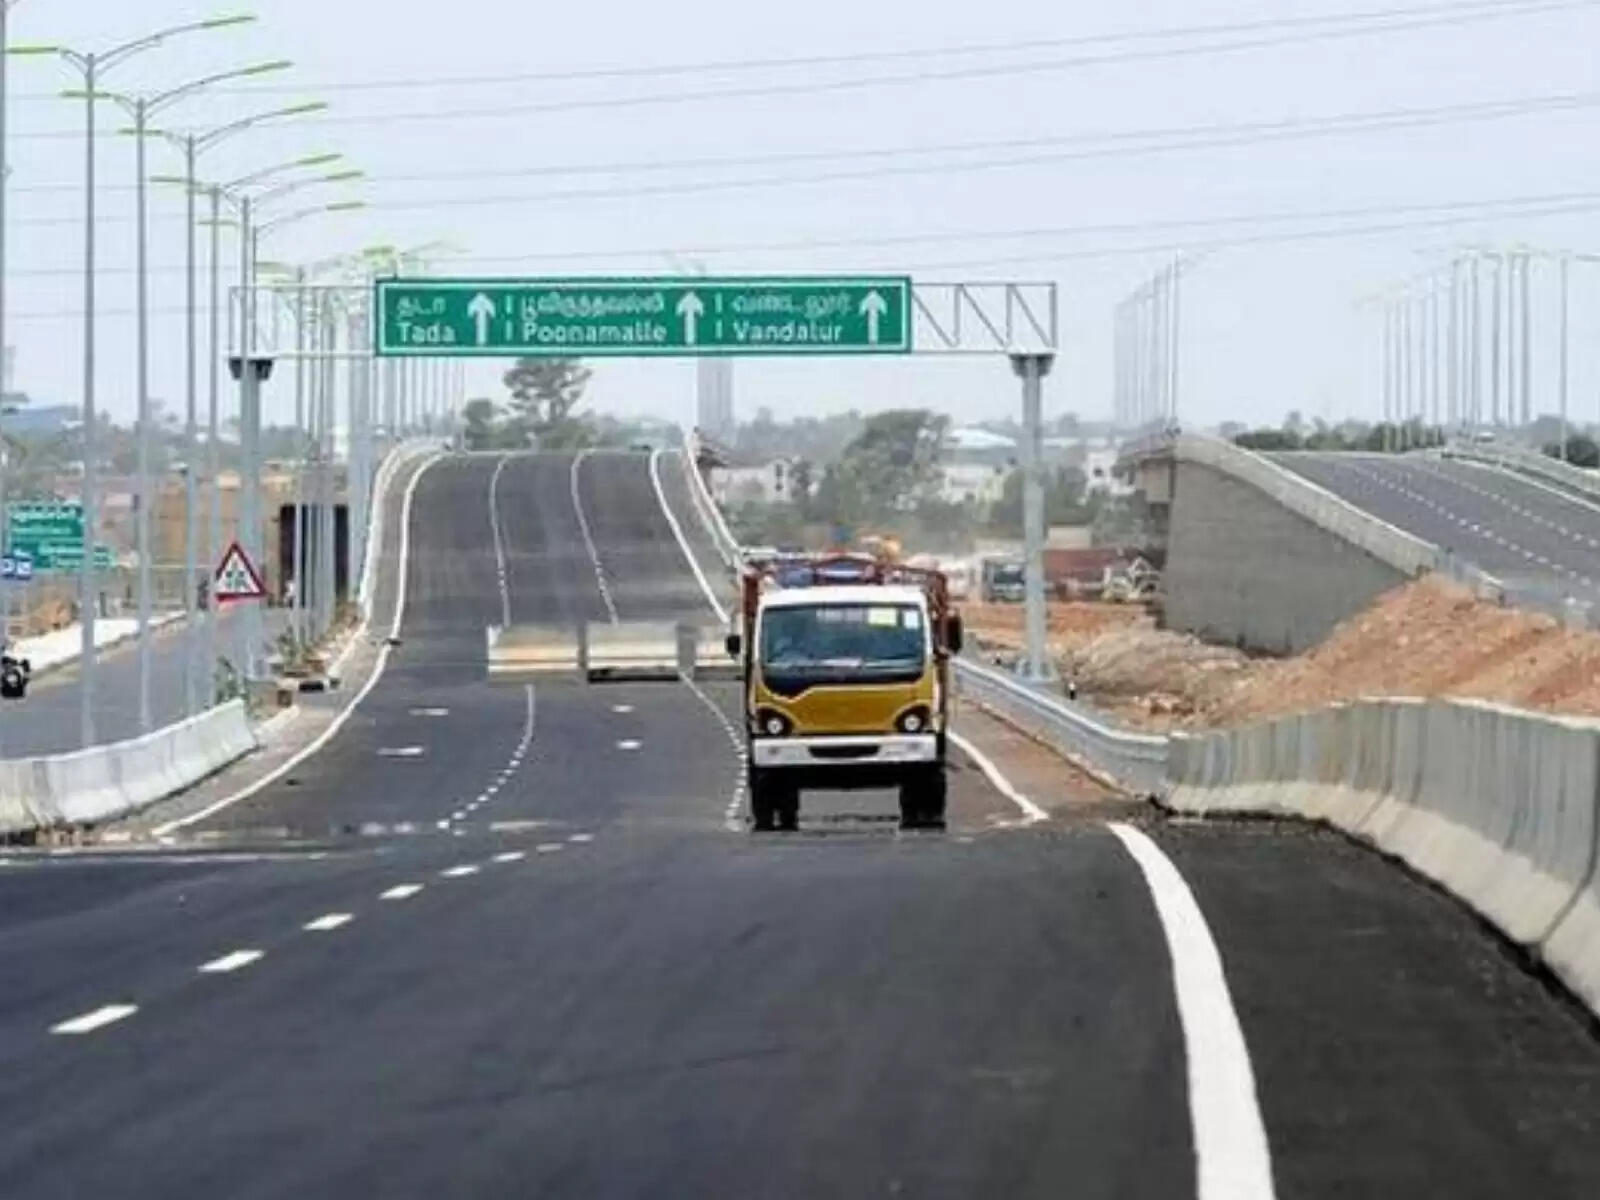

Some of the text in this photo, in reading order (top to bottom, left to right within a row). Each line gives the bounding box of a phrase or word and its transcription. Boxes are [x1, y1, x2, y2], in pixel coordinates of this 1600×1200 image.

[396, 321, 456, 343] Tada
[523, 321, 668, 343] Poonamalle
[733, 319, 843, 342] Vandalur
